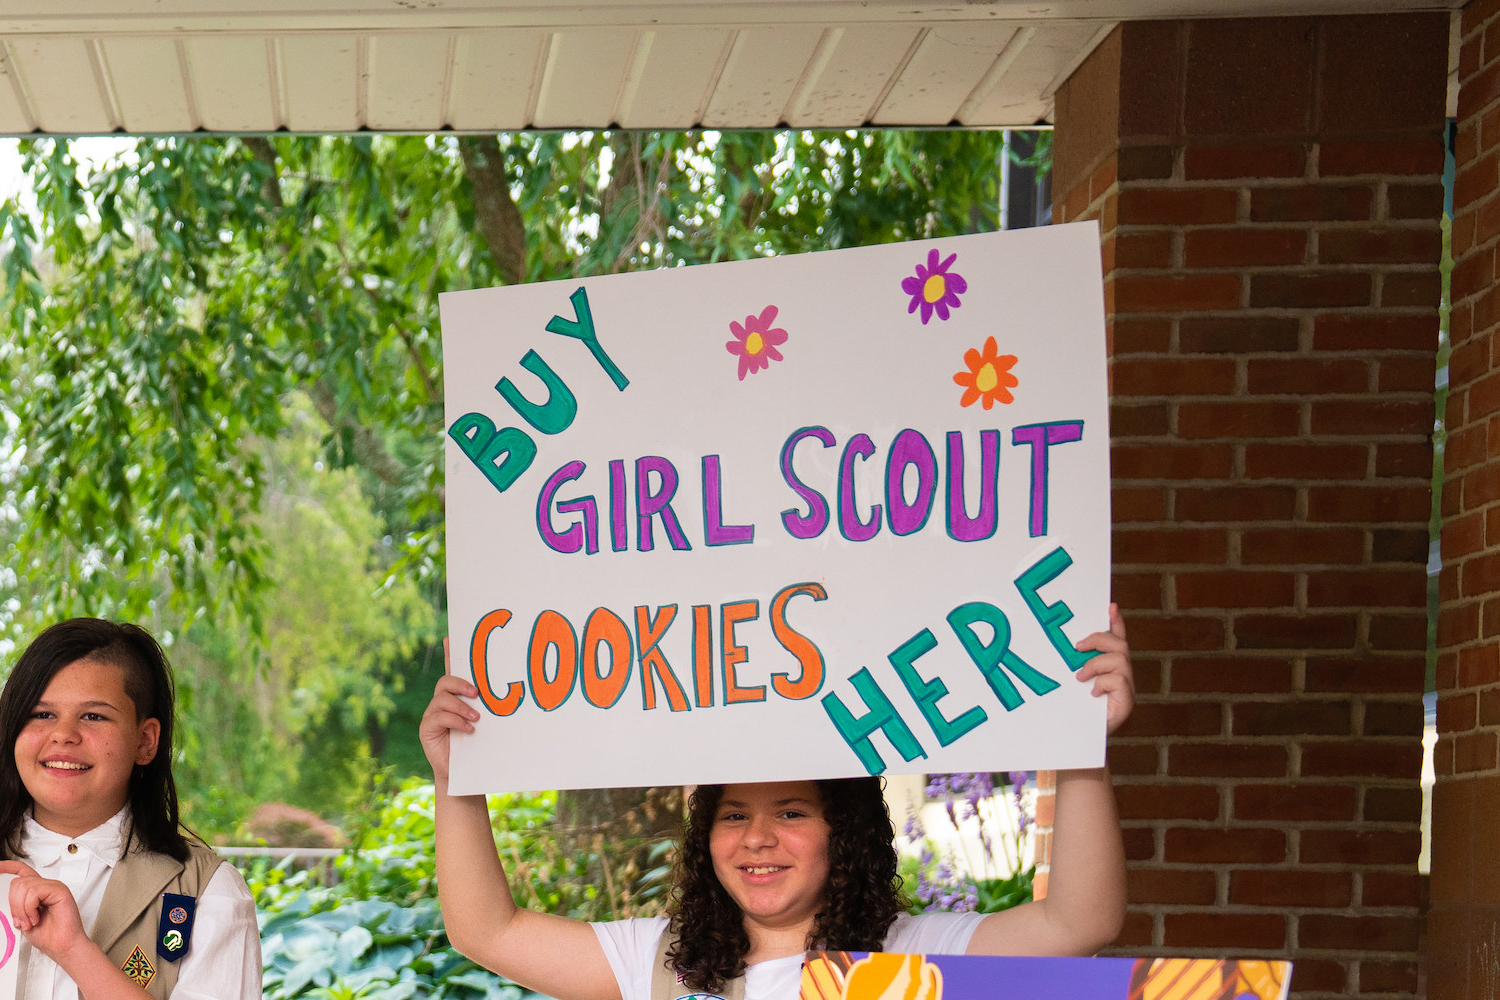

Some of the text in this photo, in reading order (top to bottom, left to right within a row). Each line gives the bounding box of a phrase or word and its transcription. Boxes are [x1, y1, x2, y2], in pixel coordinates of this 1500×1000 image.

[447, 286, 630, 493] BUY
[536, 419, 1085, 555] GIRL SCOUT
[470, 581, 829, 717] COOKIES
[820, 546, 1101, 777] HERE
